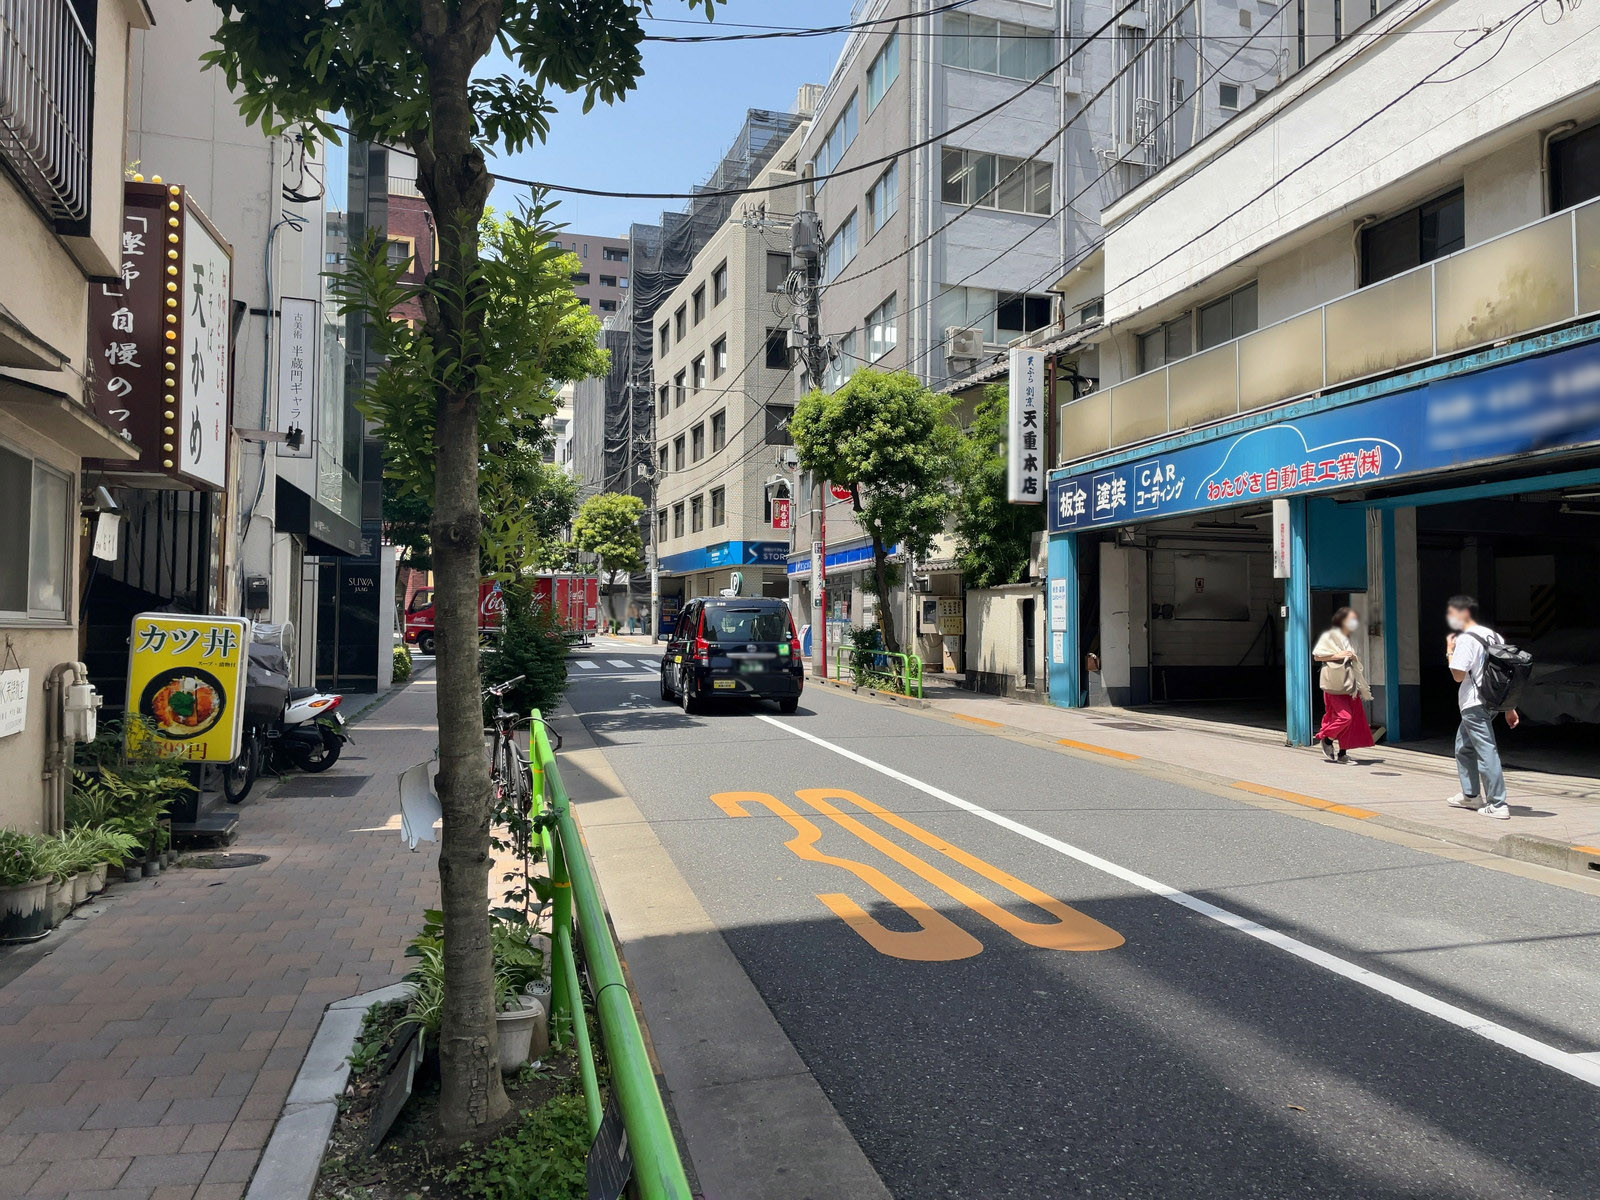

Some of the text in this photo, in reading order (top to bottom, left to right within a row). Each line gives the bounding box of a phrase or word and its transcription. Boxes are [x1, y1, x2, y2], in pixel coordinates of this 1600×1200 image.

[207, 257, 215, 353] おそば
[293, 312, 303, 339] 古美術
[189, 263, 206, 465] 天かめ
[1022, 355, 1038, 495] 天ぷら 割烹 天重本店
[1141, 464, 1176, 487] CAR
[1207, 445, 1382, 501] わたびき自動車工業(株)
[1060, 476, 1186, 518] 板金 塗装 コーティング
[763, 553, 788, 561] STOR
[348, 577, 374, 587] SUWA
[136, 623, 238, 659] カツ丼
[708, 788, 1126, 961] 30
